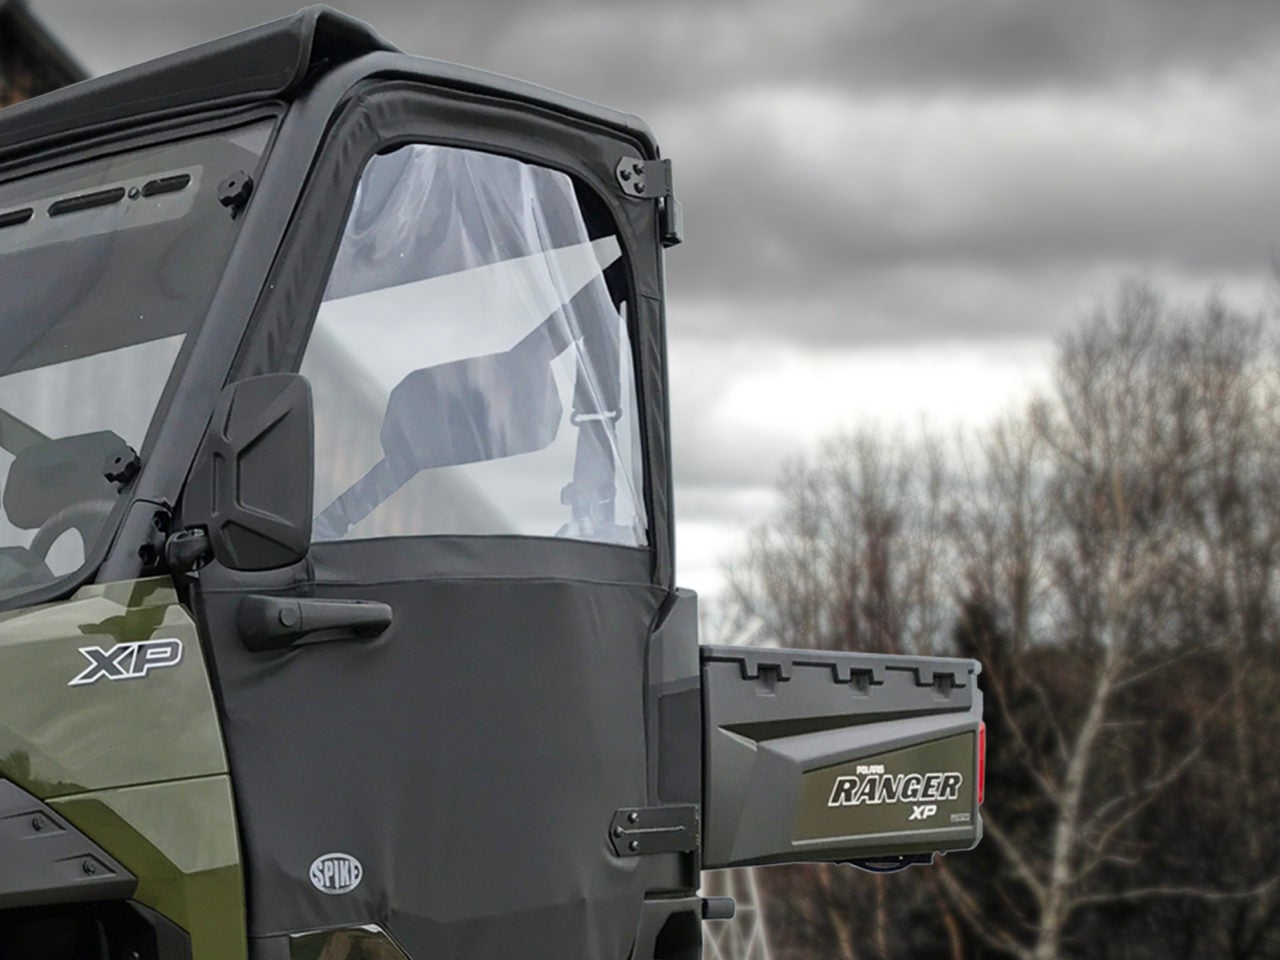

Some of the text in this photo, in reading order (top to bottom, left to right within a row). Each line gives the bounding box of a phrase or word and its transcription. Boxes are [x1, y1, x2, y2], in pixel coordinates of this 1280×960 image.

[67, 638, 183, 686] XP
[828, 772, 962, 807] RANGER
[908, 805, 937, 820] XP
[311, 858, 361, 890] SPIKE
